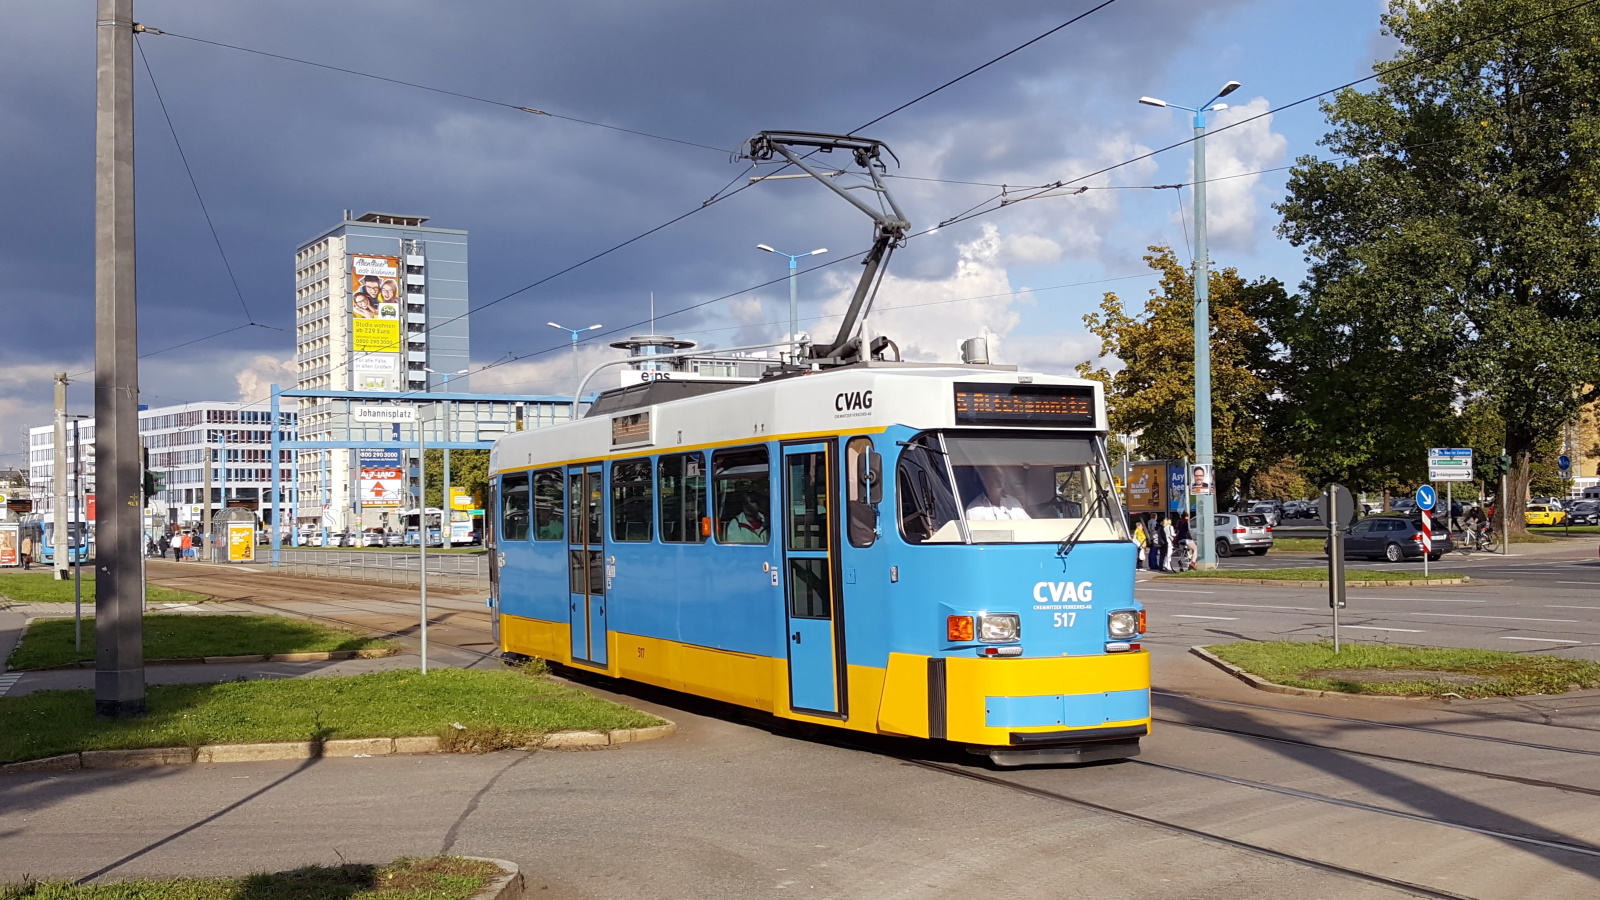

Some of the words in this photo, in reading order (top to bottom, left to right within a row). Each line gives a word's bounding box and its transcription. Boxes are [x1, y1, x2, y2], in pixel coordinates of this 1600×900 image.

[641, 368, 671, 381] eins
[835, 390, 873, 412] CVAG
[358, 408, 412, 420] Johannisplatz
[1033, 581, 1093, 603] CVAG
[1053, 612, 1077, 628] 517
